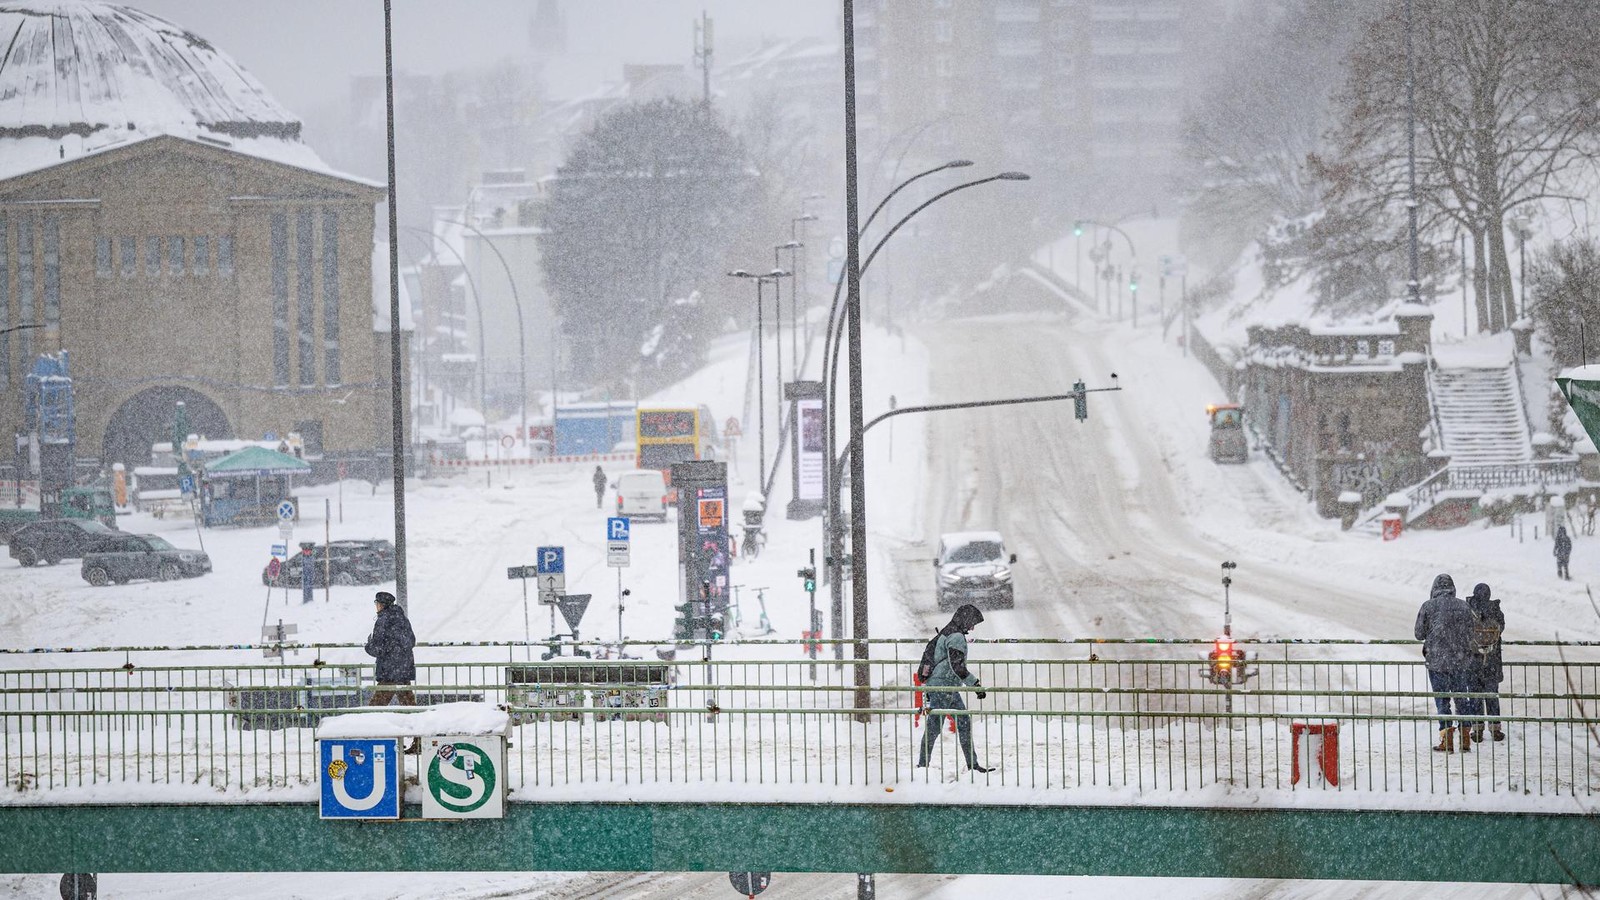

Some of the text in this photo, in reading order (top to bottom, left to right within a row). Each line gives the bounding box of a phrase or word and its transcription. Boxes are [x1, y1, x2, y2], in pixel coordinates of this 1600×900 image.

[183, 478, 191, 489] P
[612, 520, 624, 538] P
[544, 552, 557, 571] P
[331, 745, 386, 811] U
[439, 748, 486, 806] S
